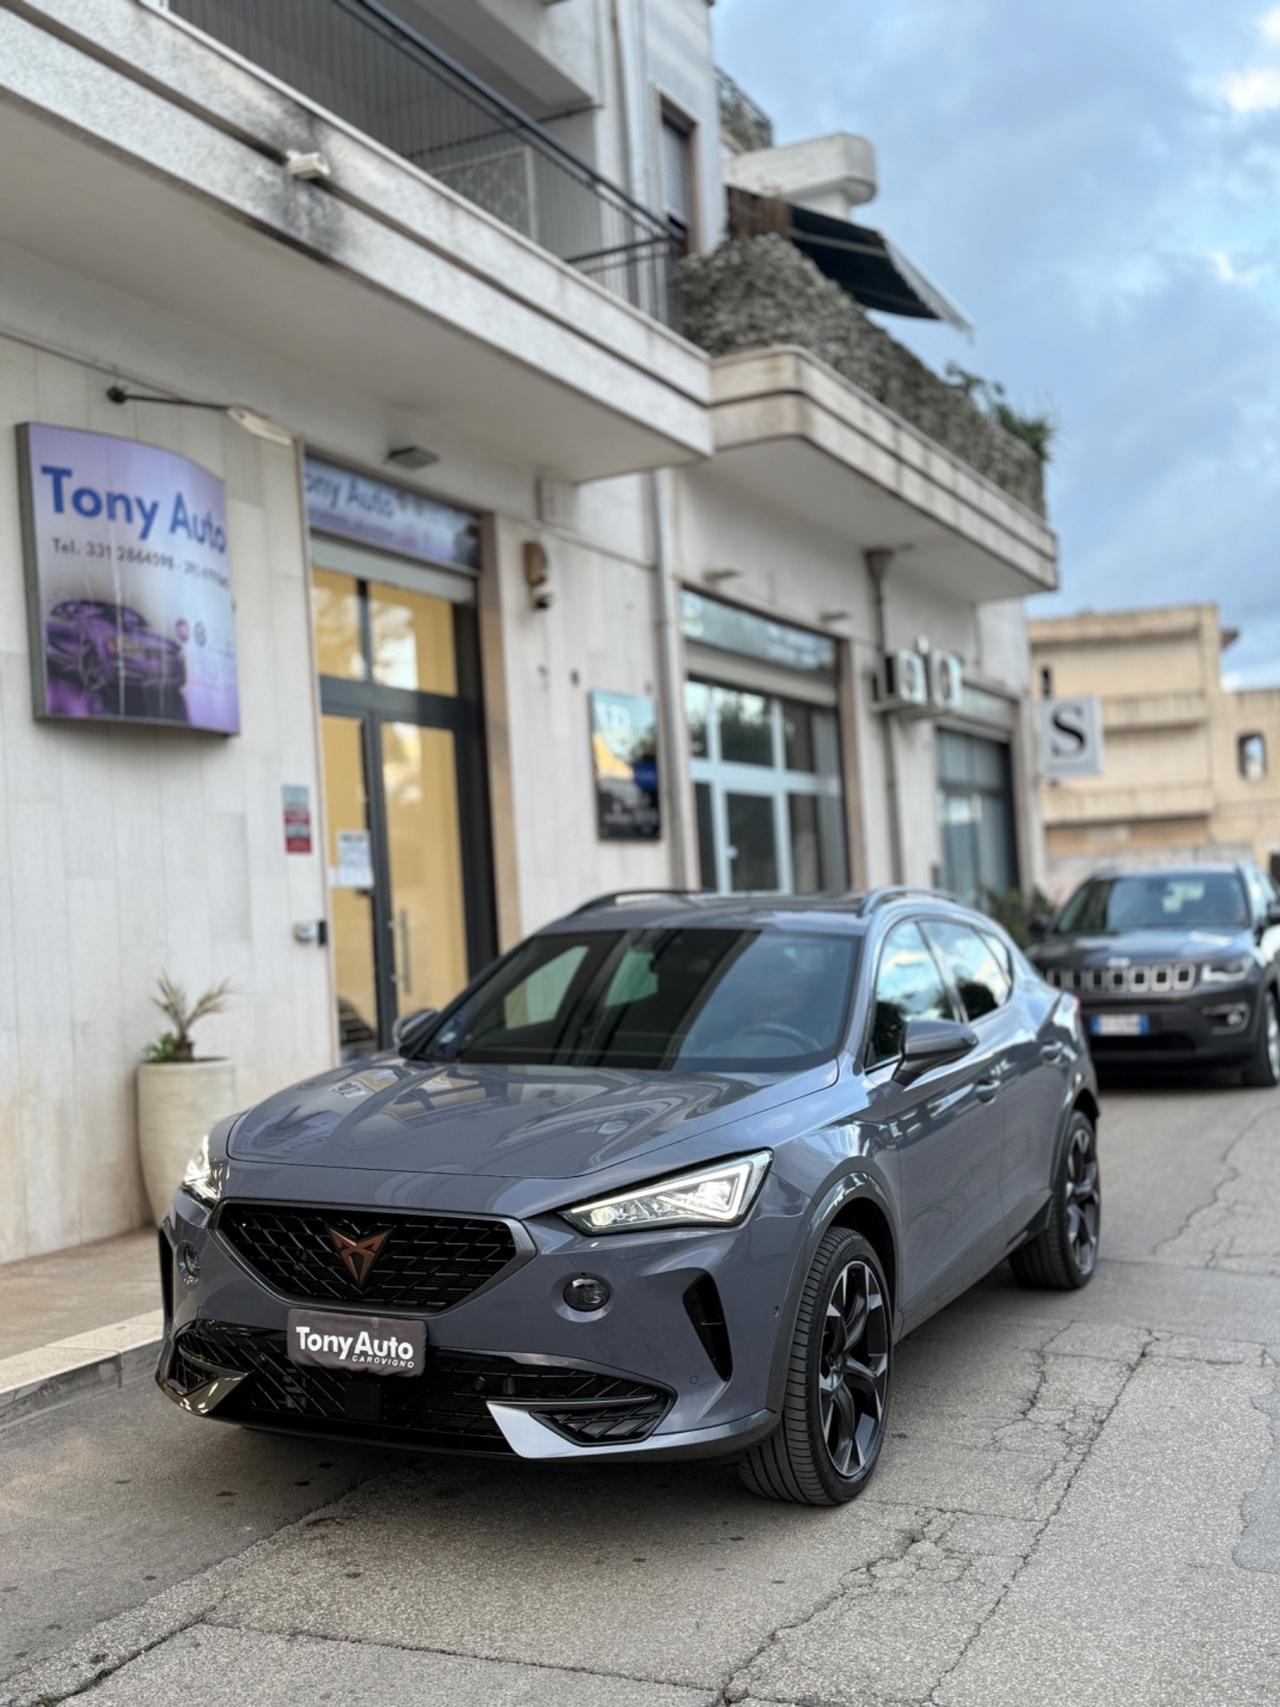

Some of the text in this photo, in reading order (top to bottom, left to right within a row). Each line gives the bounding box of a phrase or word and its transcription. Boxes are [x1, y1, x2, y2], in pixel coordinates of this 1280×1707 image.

[41, 464, 159, 541] Tony
[170, 491, 226, 554] Auto
[304, 471, 342, 509] ony
[52, 537, 80, 556] Tel.
[1050, 703, 1087, 760] S
[351, 1354, 415, 1369] CAROVIGNO
